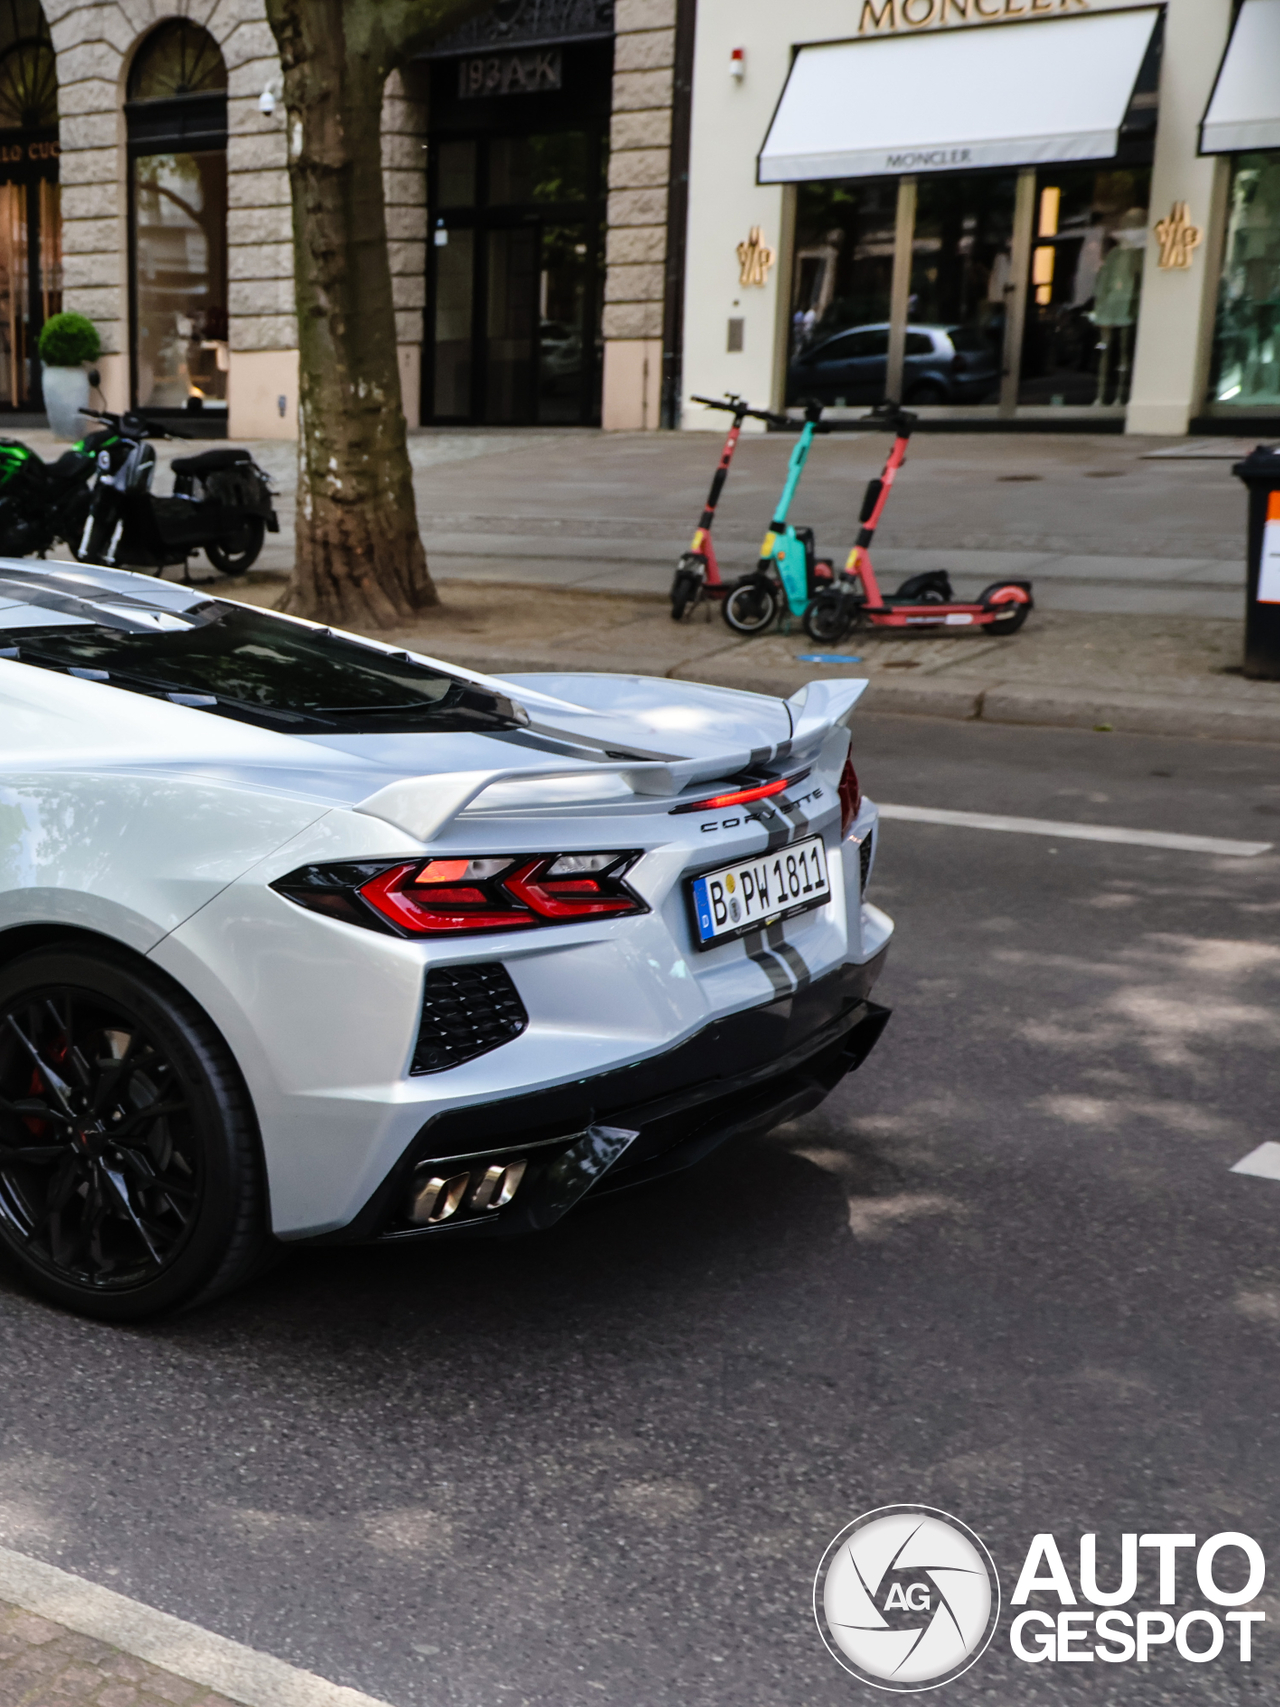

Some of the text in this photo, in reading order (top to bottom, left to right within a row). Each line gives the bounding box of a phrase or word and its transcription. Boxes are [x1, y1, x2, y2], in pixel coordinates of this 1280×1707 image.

[858, 0, 1088, 33] MONC
[886, 149, 971, 168] MONCLER
[701, 787, 824, 833] CORVETTE
[710, 881, 728, 927] B
[740, 864, 770, 916] PW
[773, 846, 826, 904] 1811
